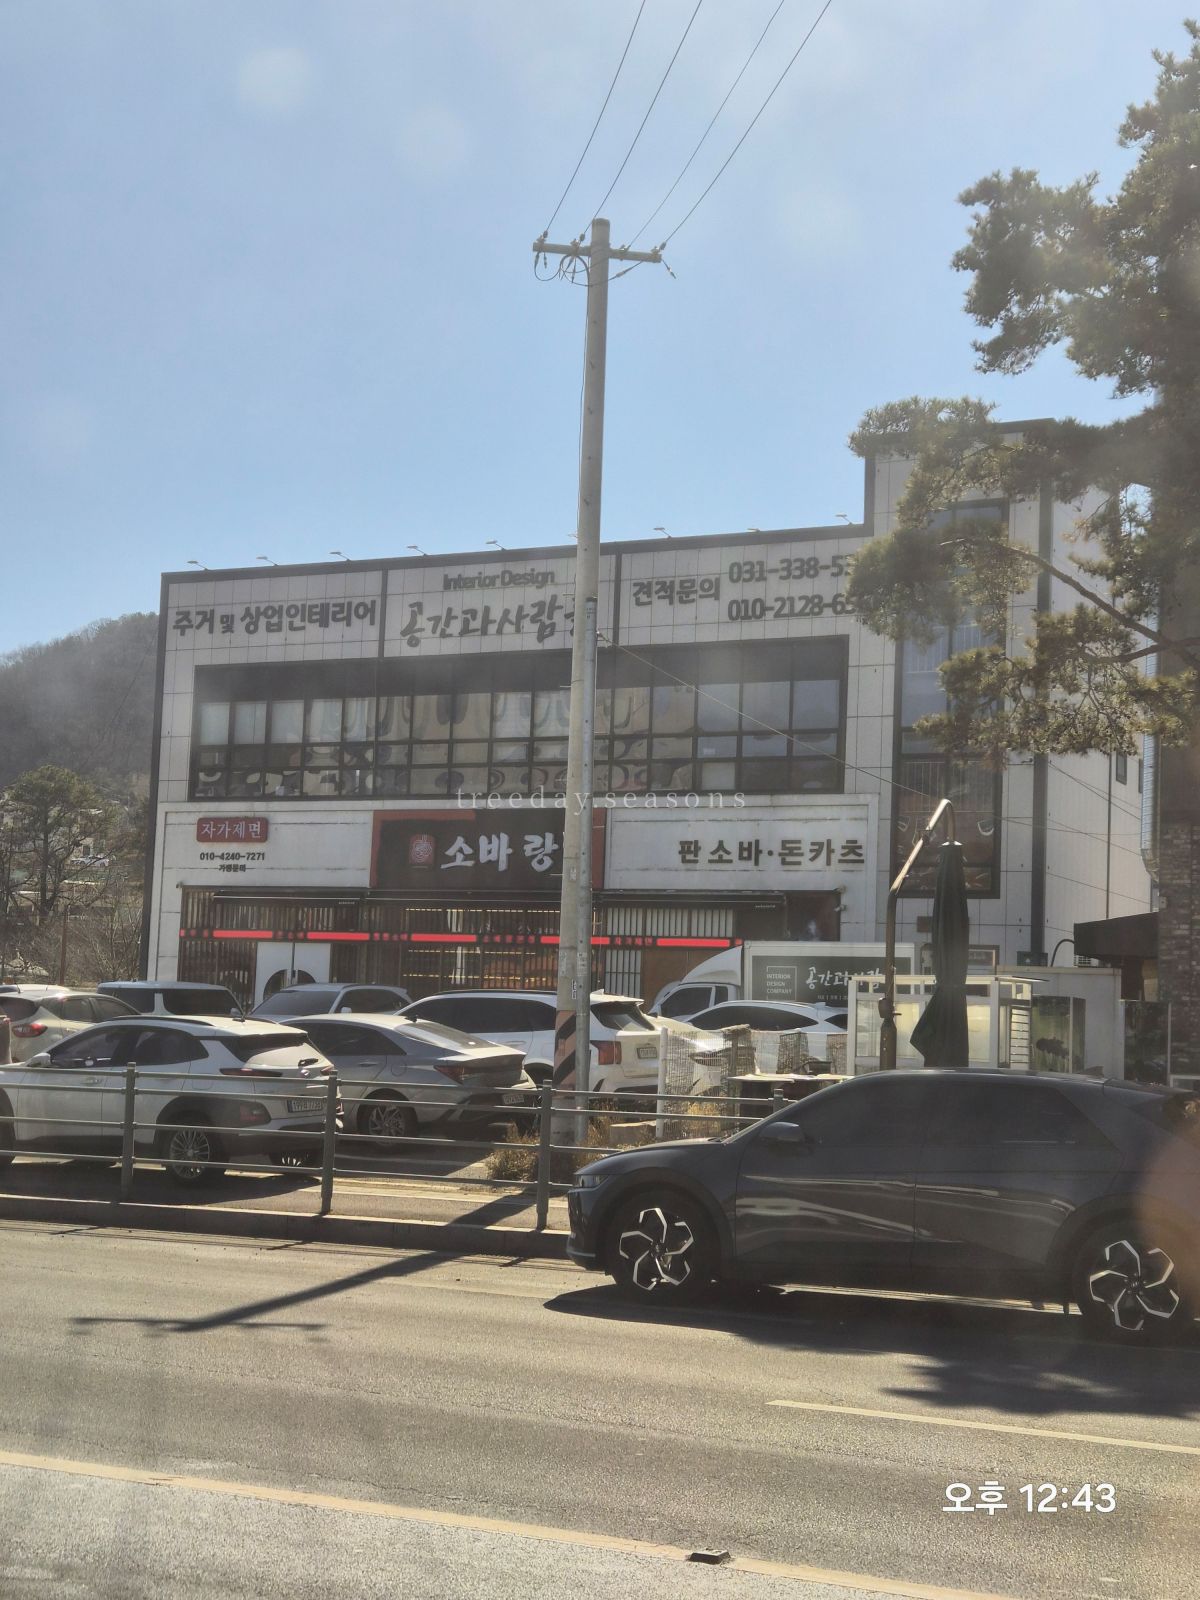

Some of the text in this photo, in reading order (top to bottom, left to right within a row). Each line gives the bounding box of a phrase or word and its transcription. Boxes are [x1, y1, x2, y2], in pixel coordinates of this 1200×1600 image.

[443, 567, 555, 591] Interior Design
[633, 577, 721, 607] 견적문의
[173, 599, 376, 636] 주거 및 상업인테리어
[400, 594, 575, 648] 공간과사람
[200, 820, 263, 839] 자가제면
[199, 852, 265, 861] 010-4240-7271
